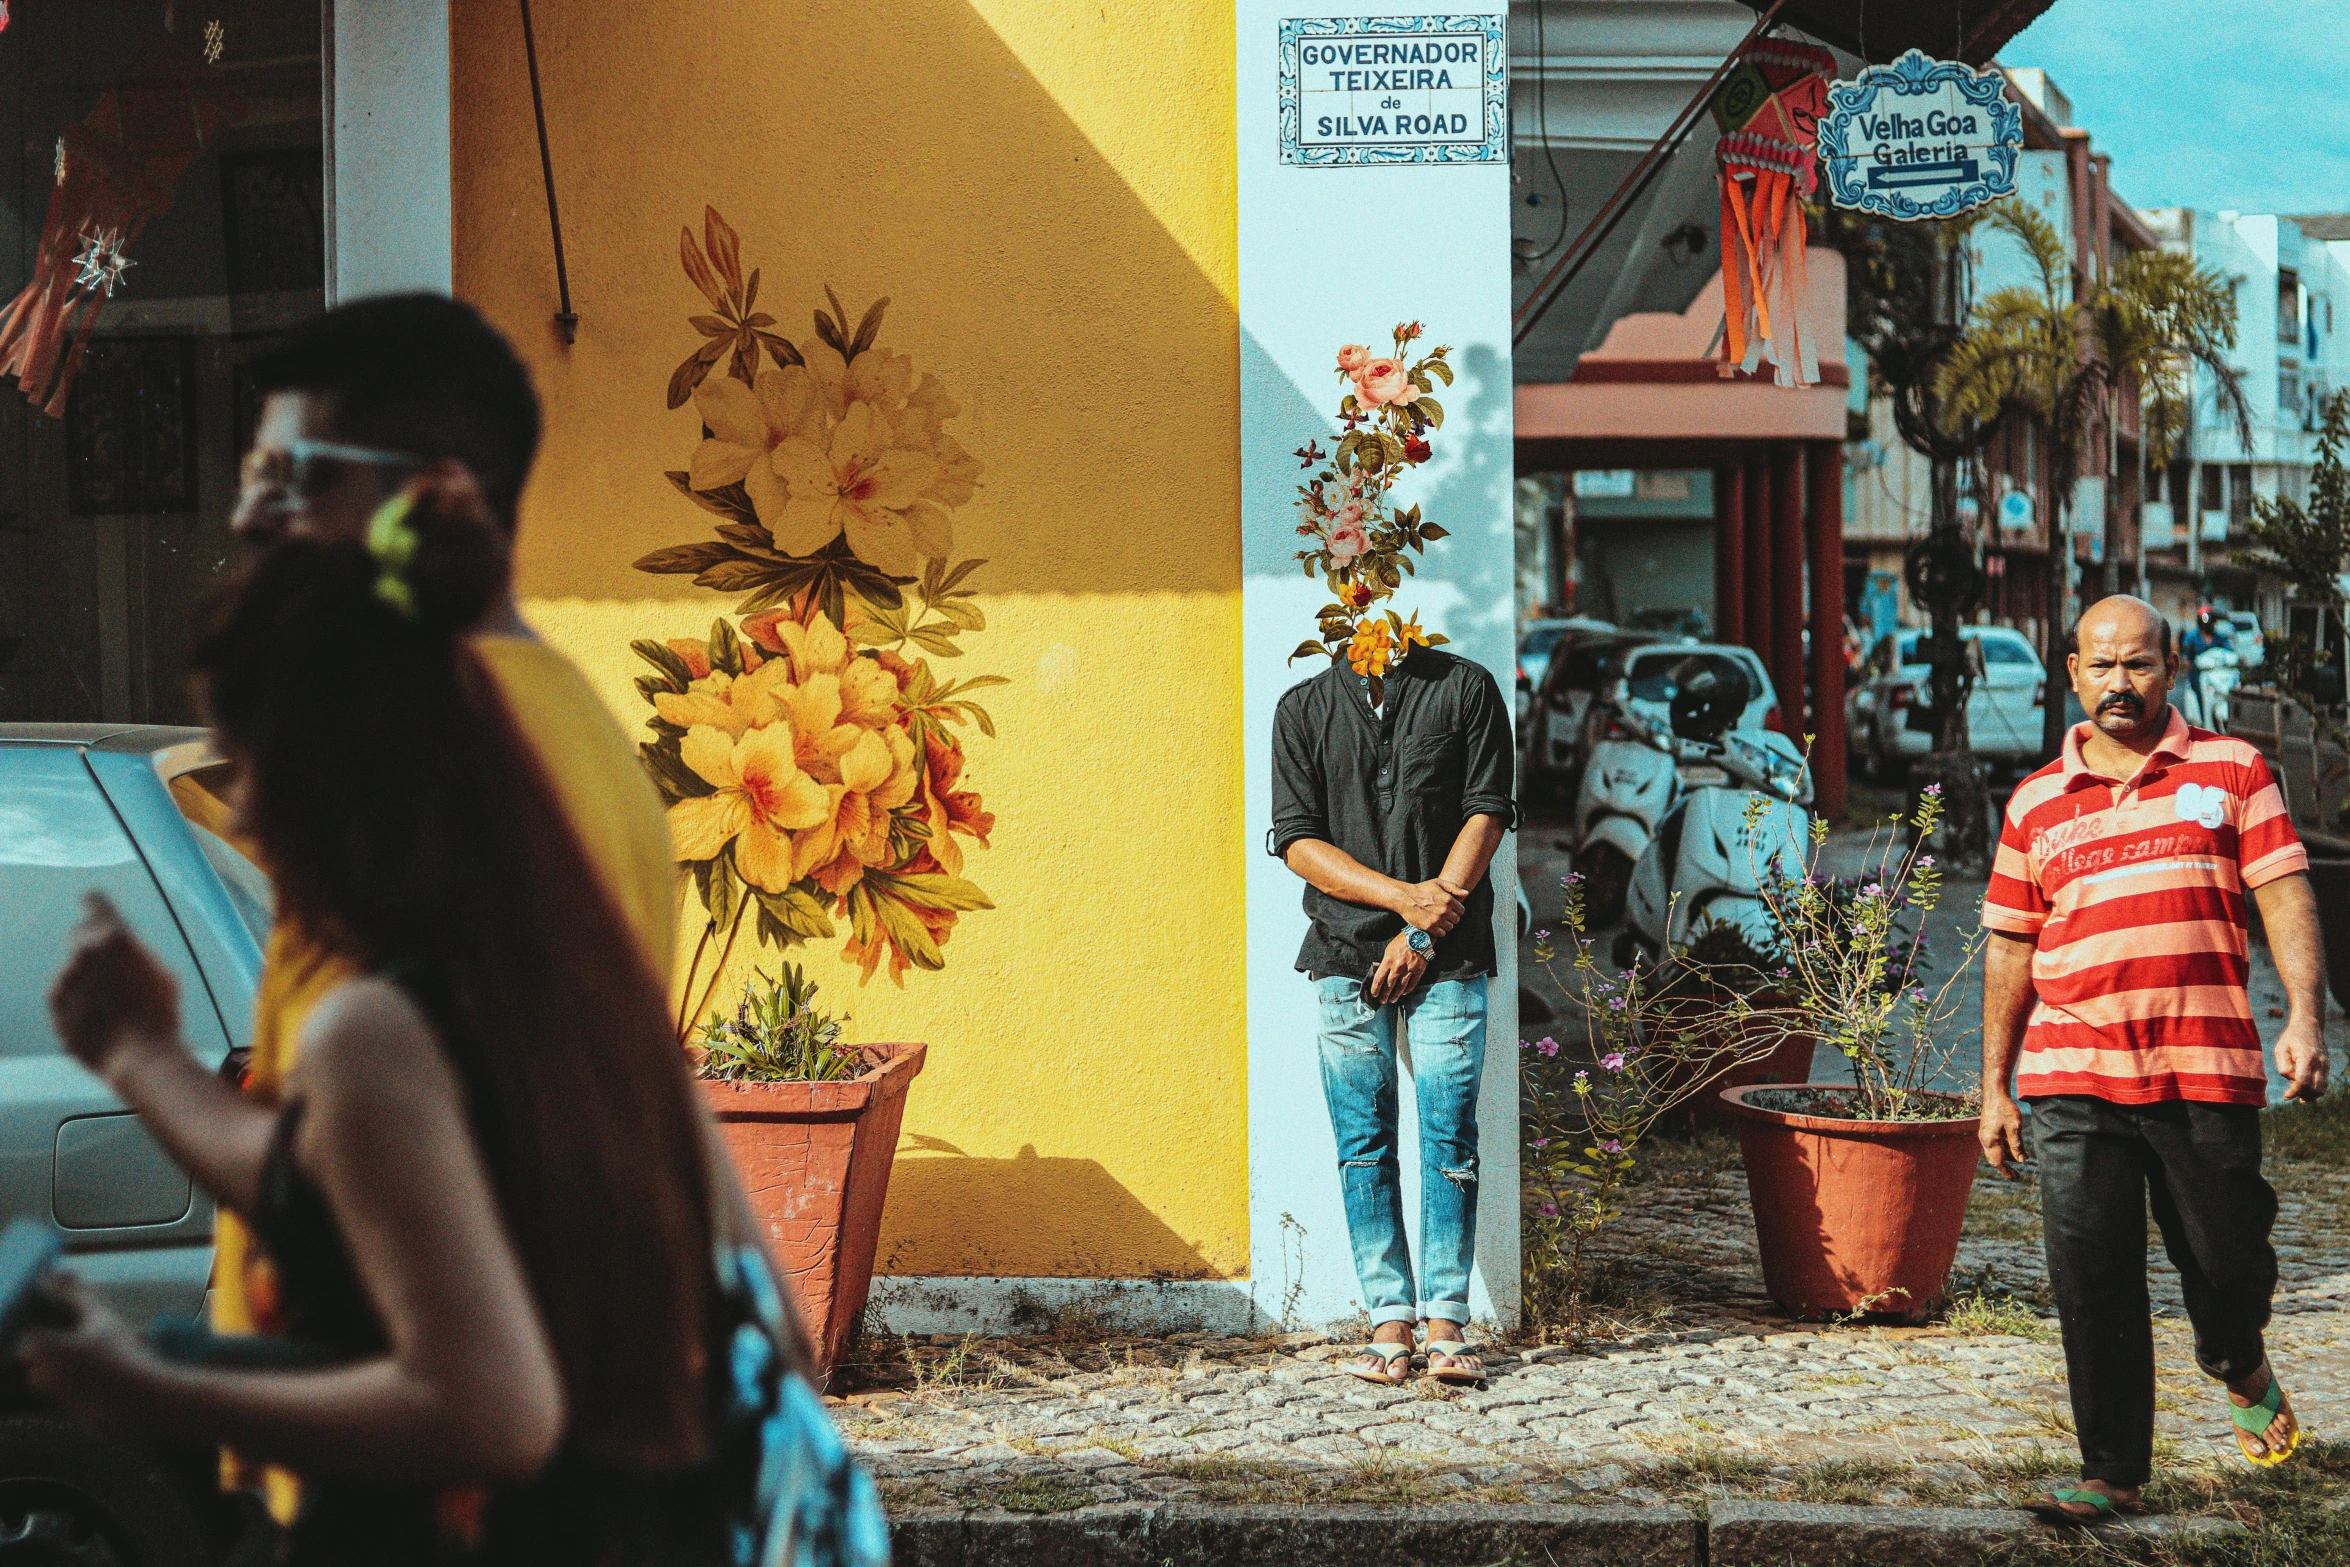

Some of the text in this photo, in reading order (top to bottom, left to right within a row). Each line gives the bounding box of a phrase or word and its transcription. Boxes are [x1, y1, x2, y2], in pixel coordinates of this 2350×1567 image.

[1302, 43, 1478, 66] GOVERNADOR
[1329, 69, 1453, 91] TEIXEIRA
[1380, 96, 1401, 110] de
[1317, 114, 1468, 137] SILVA ROAD
[1858, 109, 1978, 141] Velha Goa
[1873, 141, 1968, 166] Galeria
